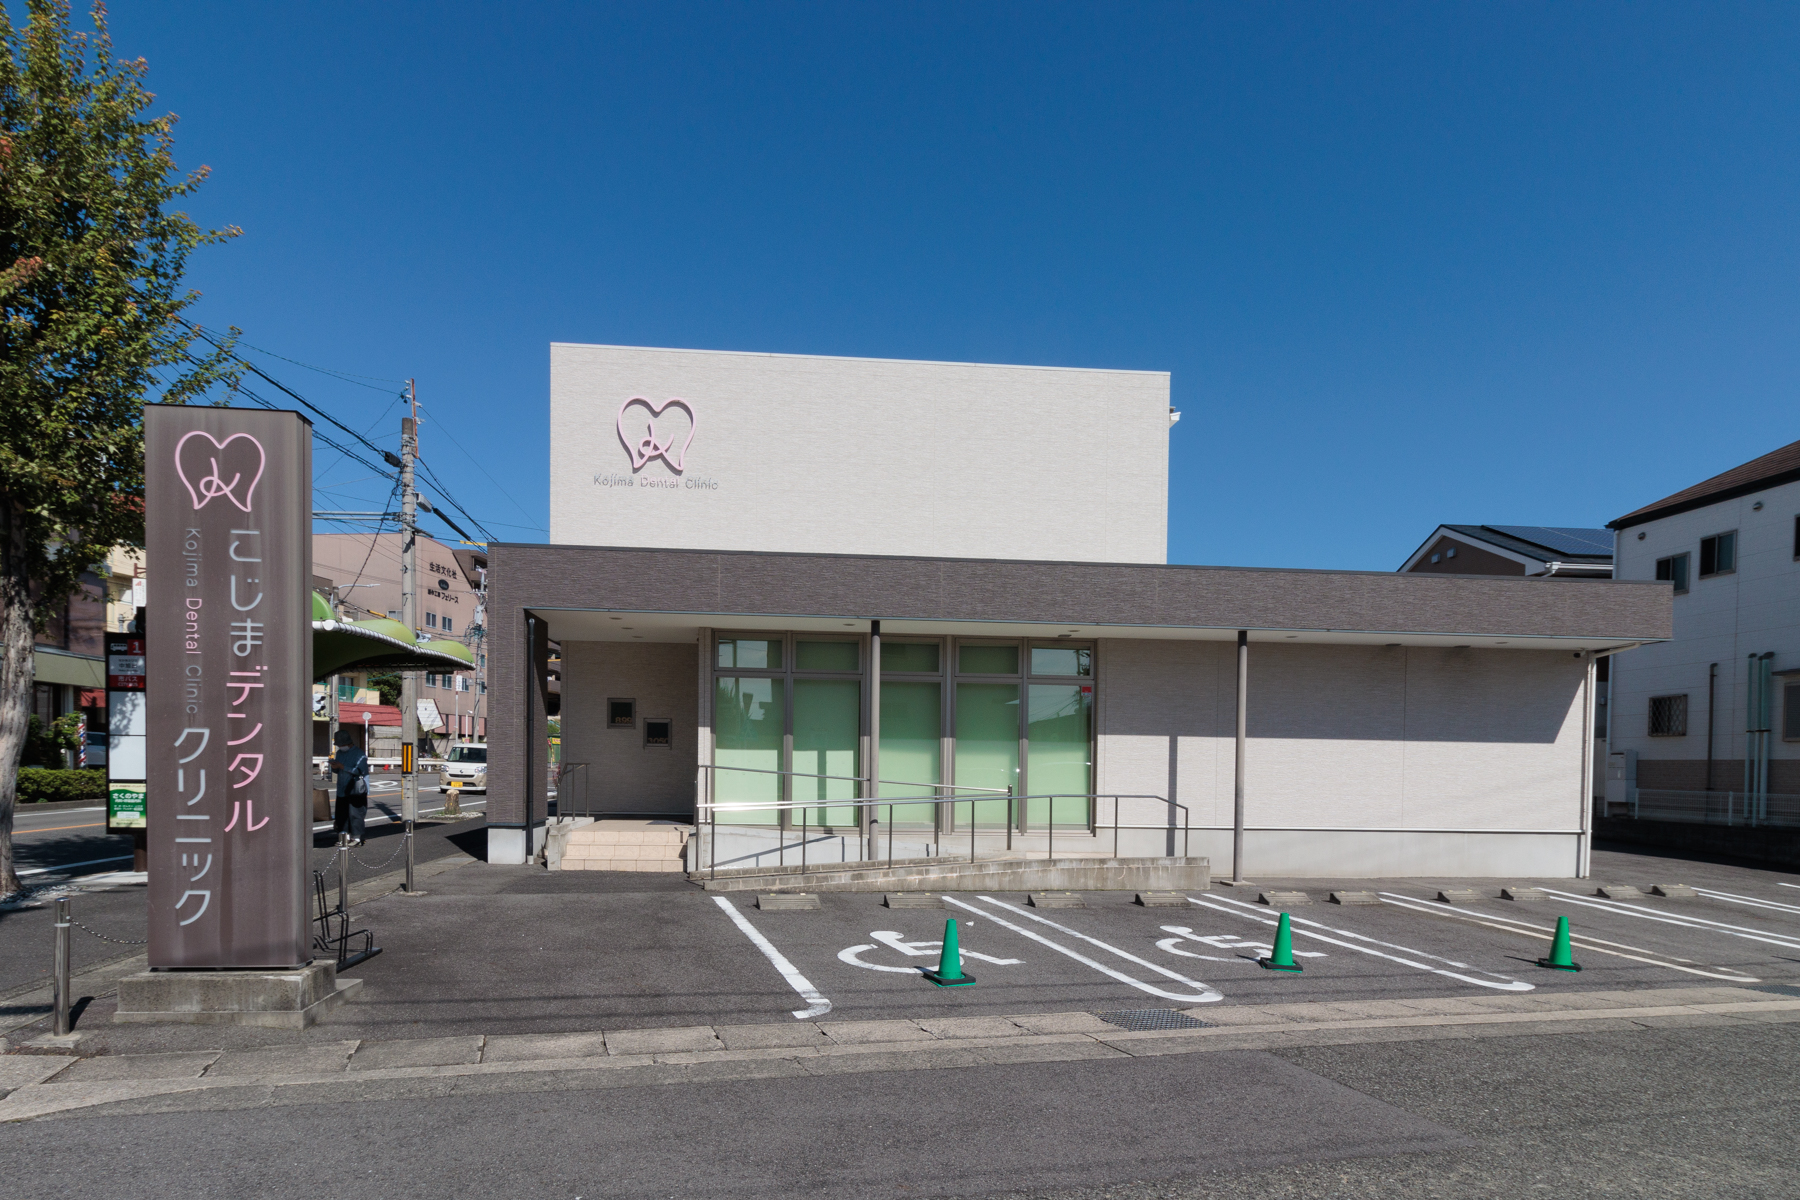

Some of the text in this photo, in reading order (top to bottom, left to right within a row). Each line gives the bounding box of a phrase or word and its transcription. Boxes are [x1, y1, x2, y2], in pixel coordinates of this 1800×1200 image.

[593, 473, 719, 490] Kojima Dental Clinic
[132, 641, 141, 654] 1
[182, 528, 202, 714] Kojima Dental Clinic
[223, 529, 270, 834] こじまデンタル
[173, 727, 213, 926] クリニック
